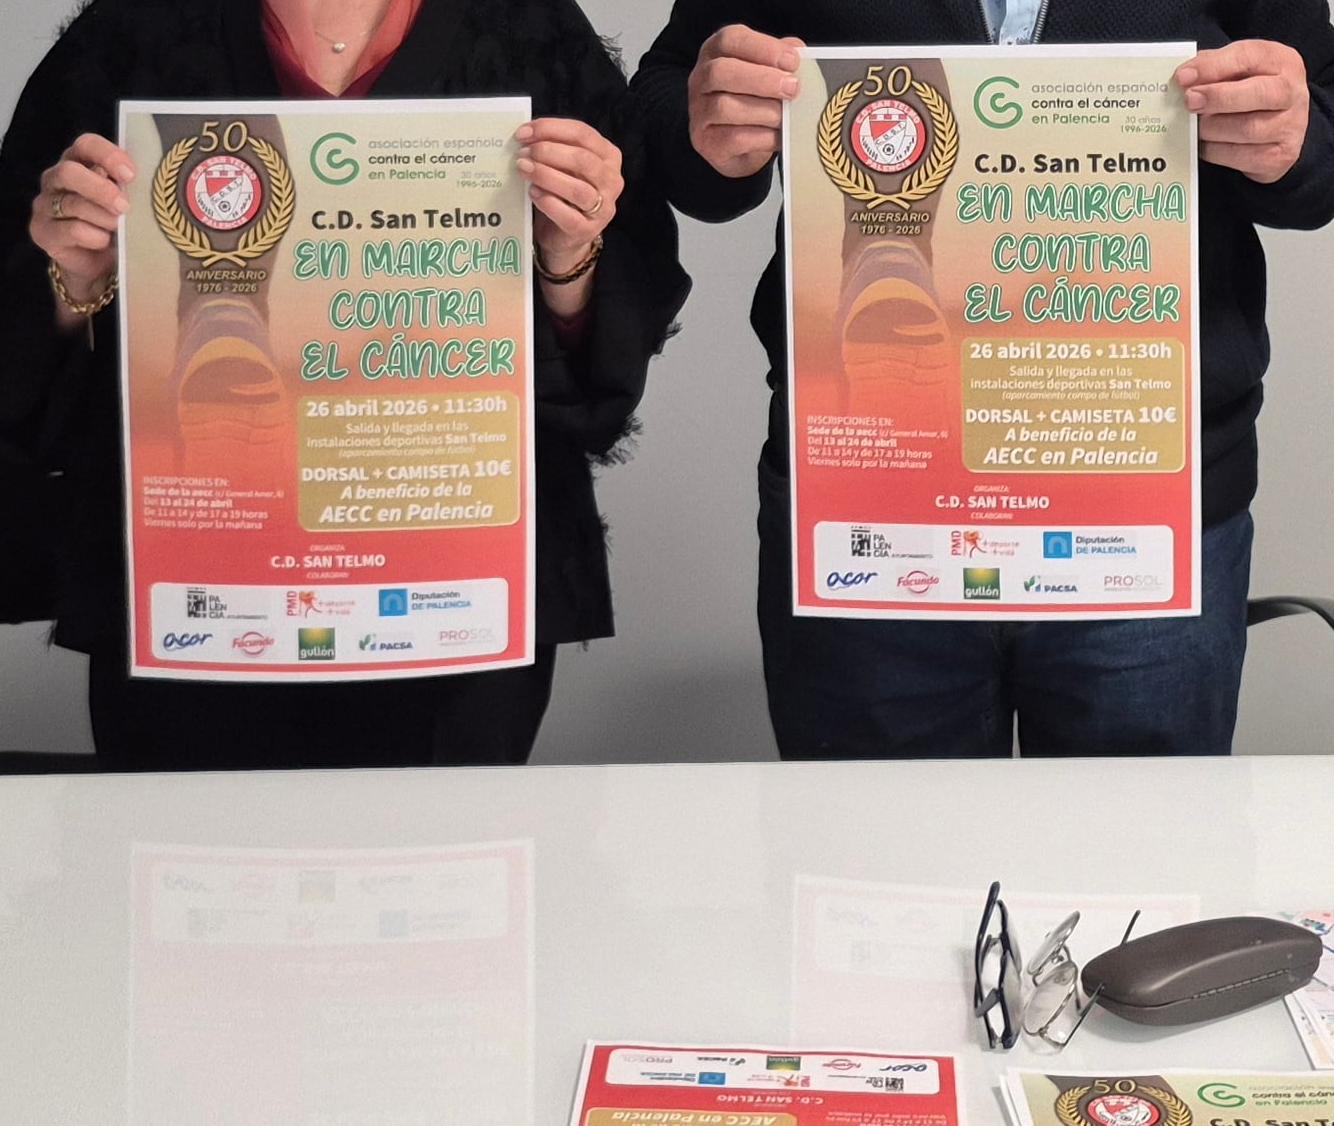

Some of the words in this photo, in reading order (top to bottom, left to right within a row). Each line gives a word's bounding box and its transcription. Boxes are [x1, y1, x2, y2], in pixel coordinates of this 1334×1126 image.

[368, 153, 410, 164] contra
[414, 153, 426, 164] el
[429, 152, 476, 164] cáncer
[974, 153, 1026, 173] C.D.
[1033, 153, 1080, 173] San
[1086, 152, 1166, 173] Telmo
[955, 181, 1013, 223] EN
[1024, 181, 1186, 223] MARCHA
[311, 209, 363, 229] C.D.
[370, 209, 417, 229] San
[423, 207, 502, 228] Telmo
[850, 211, 930, 222] ANIVERSARIO
[292, 237, 350, 280] EN
[361, 235, 521, 279] MARCHA
[991, 231, 1151, 273] CONTRA
[327, 286, 486, 330] CONTRA
[962, 282, 1013, 323] EL
[1022, 275, 1181, 323] CÁNCER
[299, 338, 349, 381] EL
[358, 331, 516, 380] CÁNCER
[969, 343, 993, 359] 26
[996, 342, 1041, 359] abril
[1045, 343, 1091, 359] 2026
[1107, 343, 1172, 359] 11:30h
[305, 401, 329, 418] 26
[333, 399, 377, 417] abril
[382, 398, 427, 416] 2026
[443, 397, 507, 414] 11:30h
[982, 447, 1036, 465] AECC
[1040, 450, 1065, 465] en
[1069, 446, 1158, 465] Palencia
[1092, 1078, 1138, 1095] 50
[715, 1093, 755, 1104] TELMO
[755, 1095, 792, 1105] SAN
[610, 1109, 696, 1125] Palencia
[698, 1112, 722, 1126] en
[725, 1112, 777, 1126] AECC
